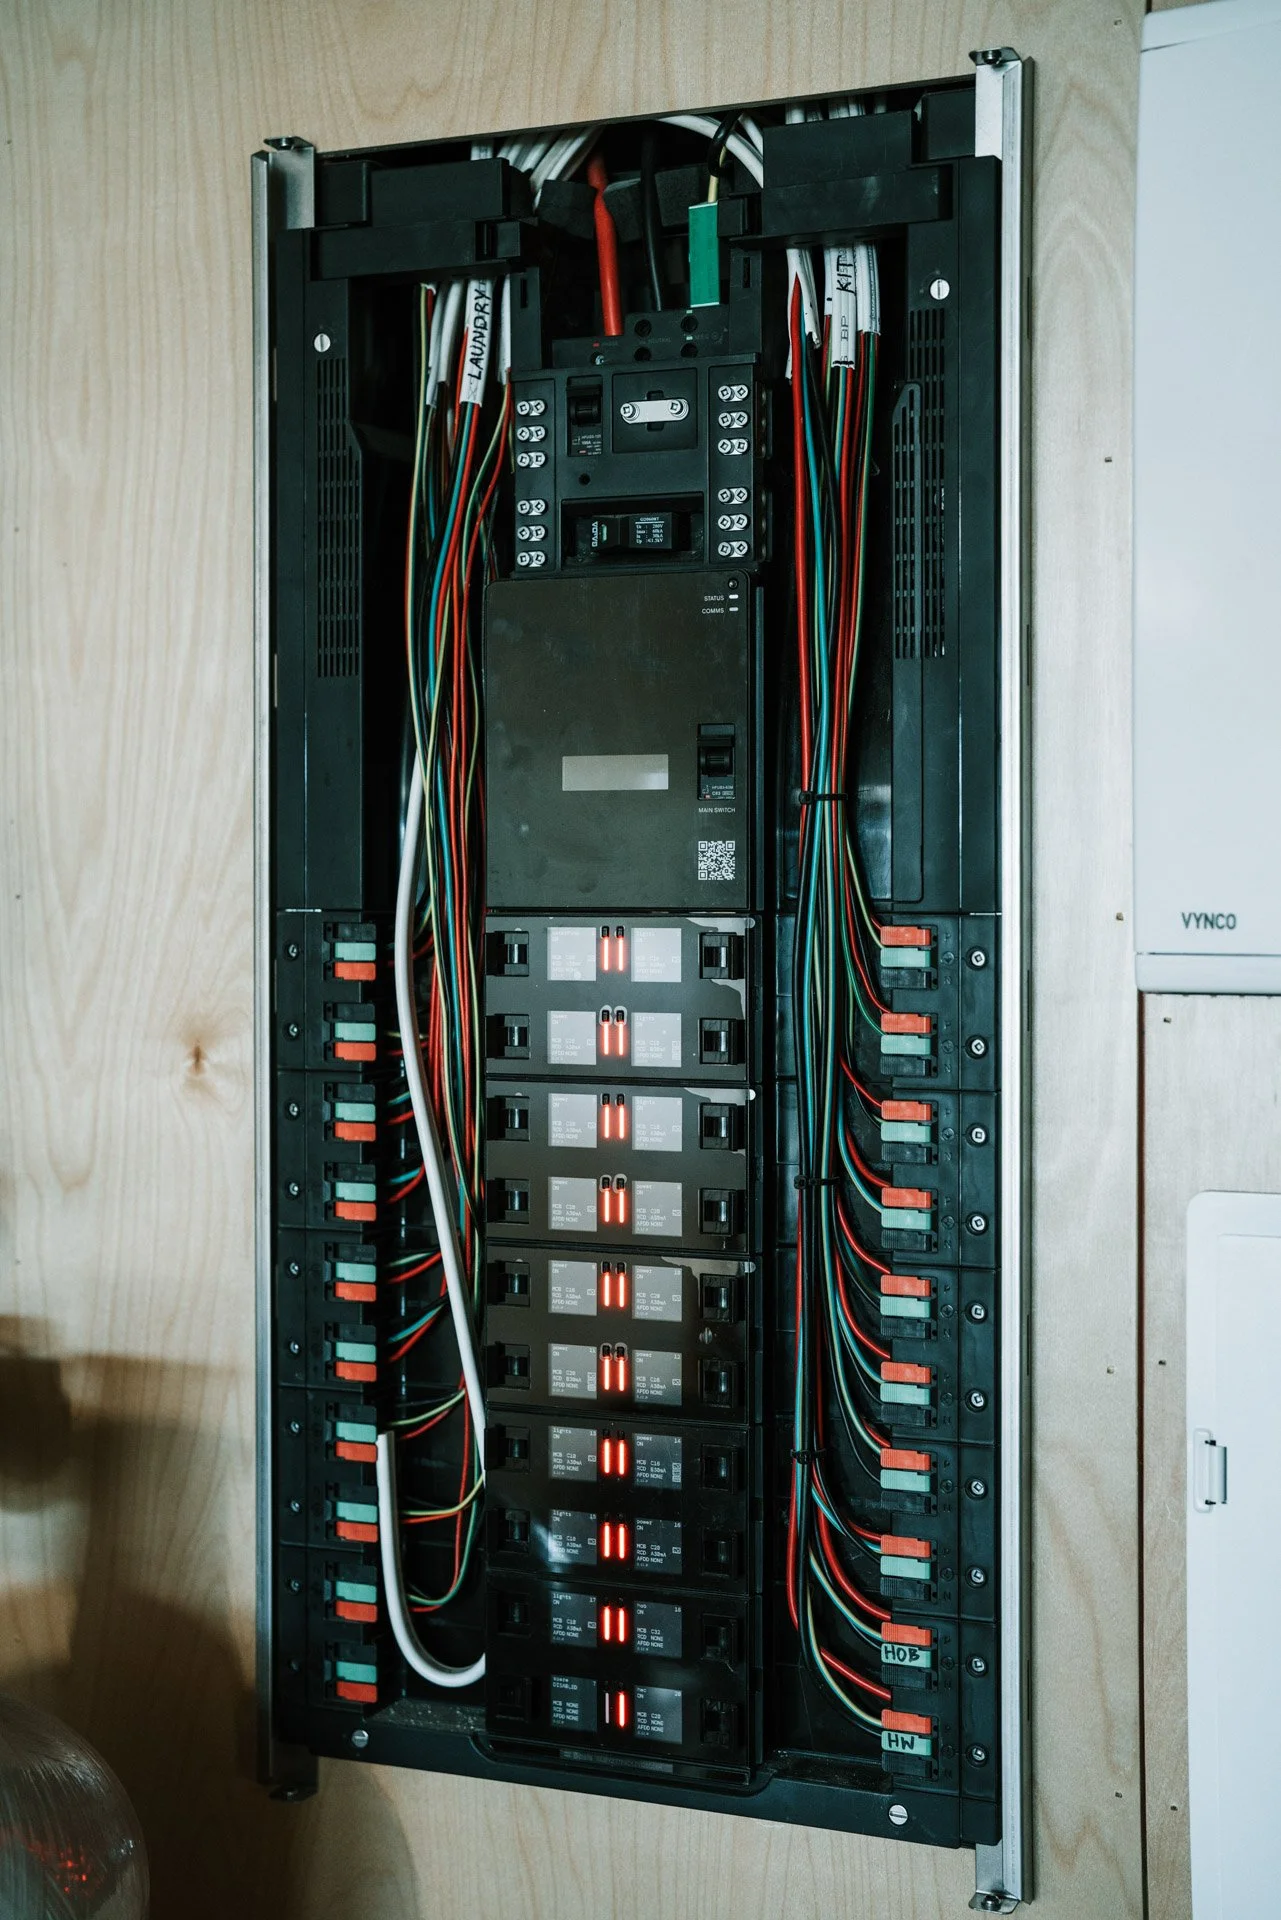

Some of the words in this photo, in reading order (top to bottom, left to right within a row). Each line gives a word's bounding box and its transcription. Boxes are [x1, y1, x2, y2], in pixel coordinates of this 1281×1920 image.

[836, 255, 857, 297] KIT
[468, 288, 492, 380] LAUNDRY
[1182, 912, 1237, 929] VYNCO
[884, 1645, 920, 1662] HOB
[887, 1732, 914, 1750] HW
